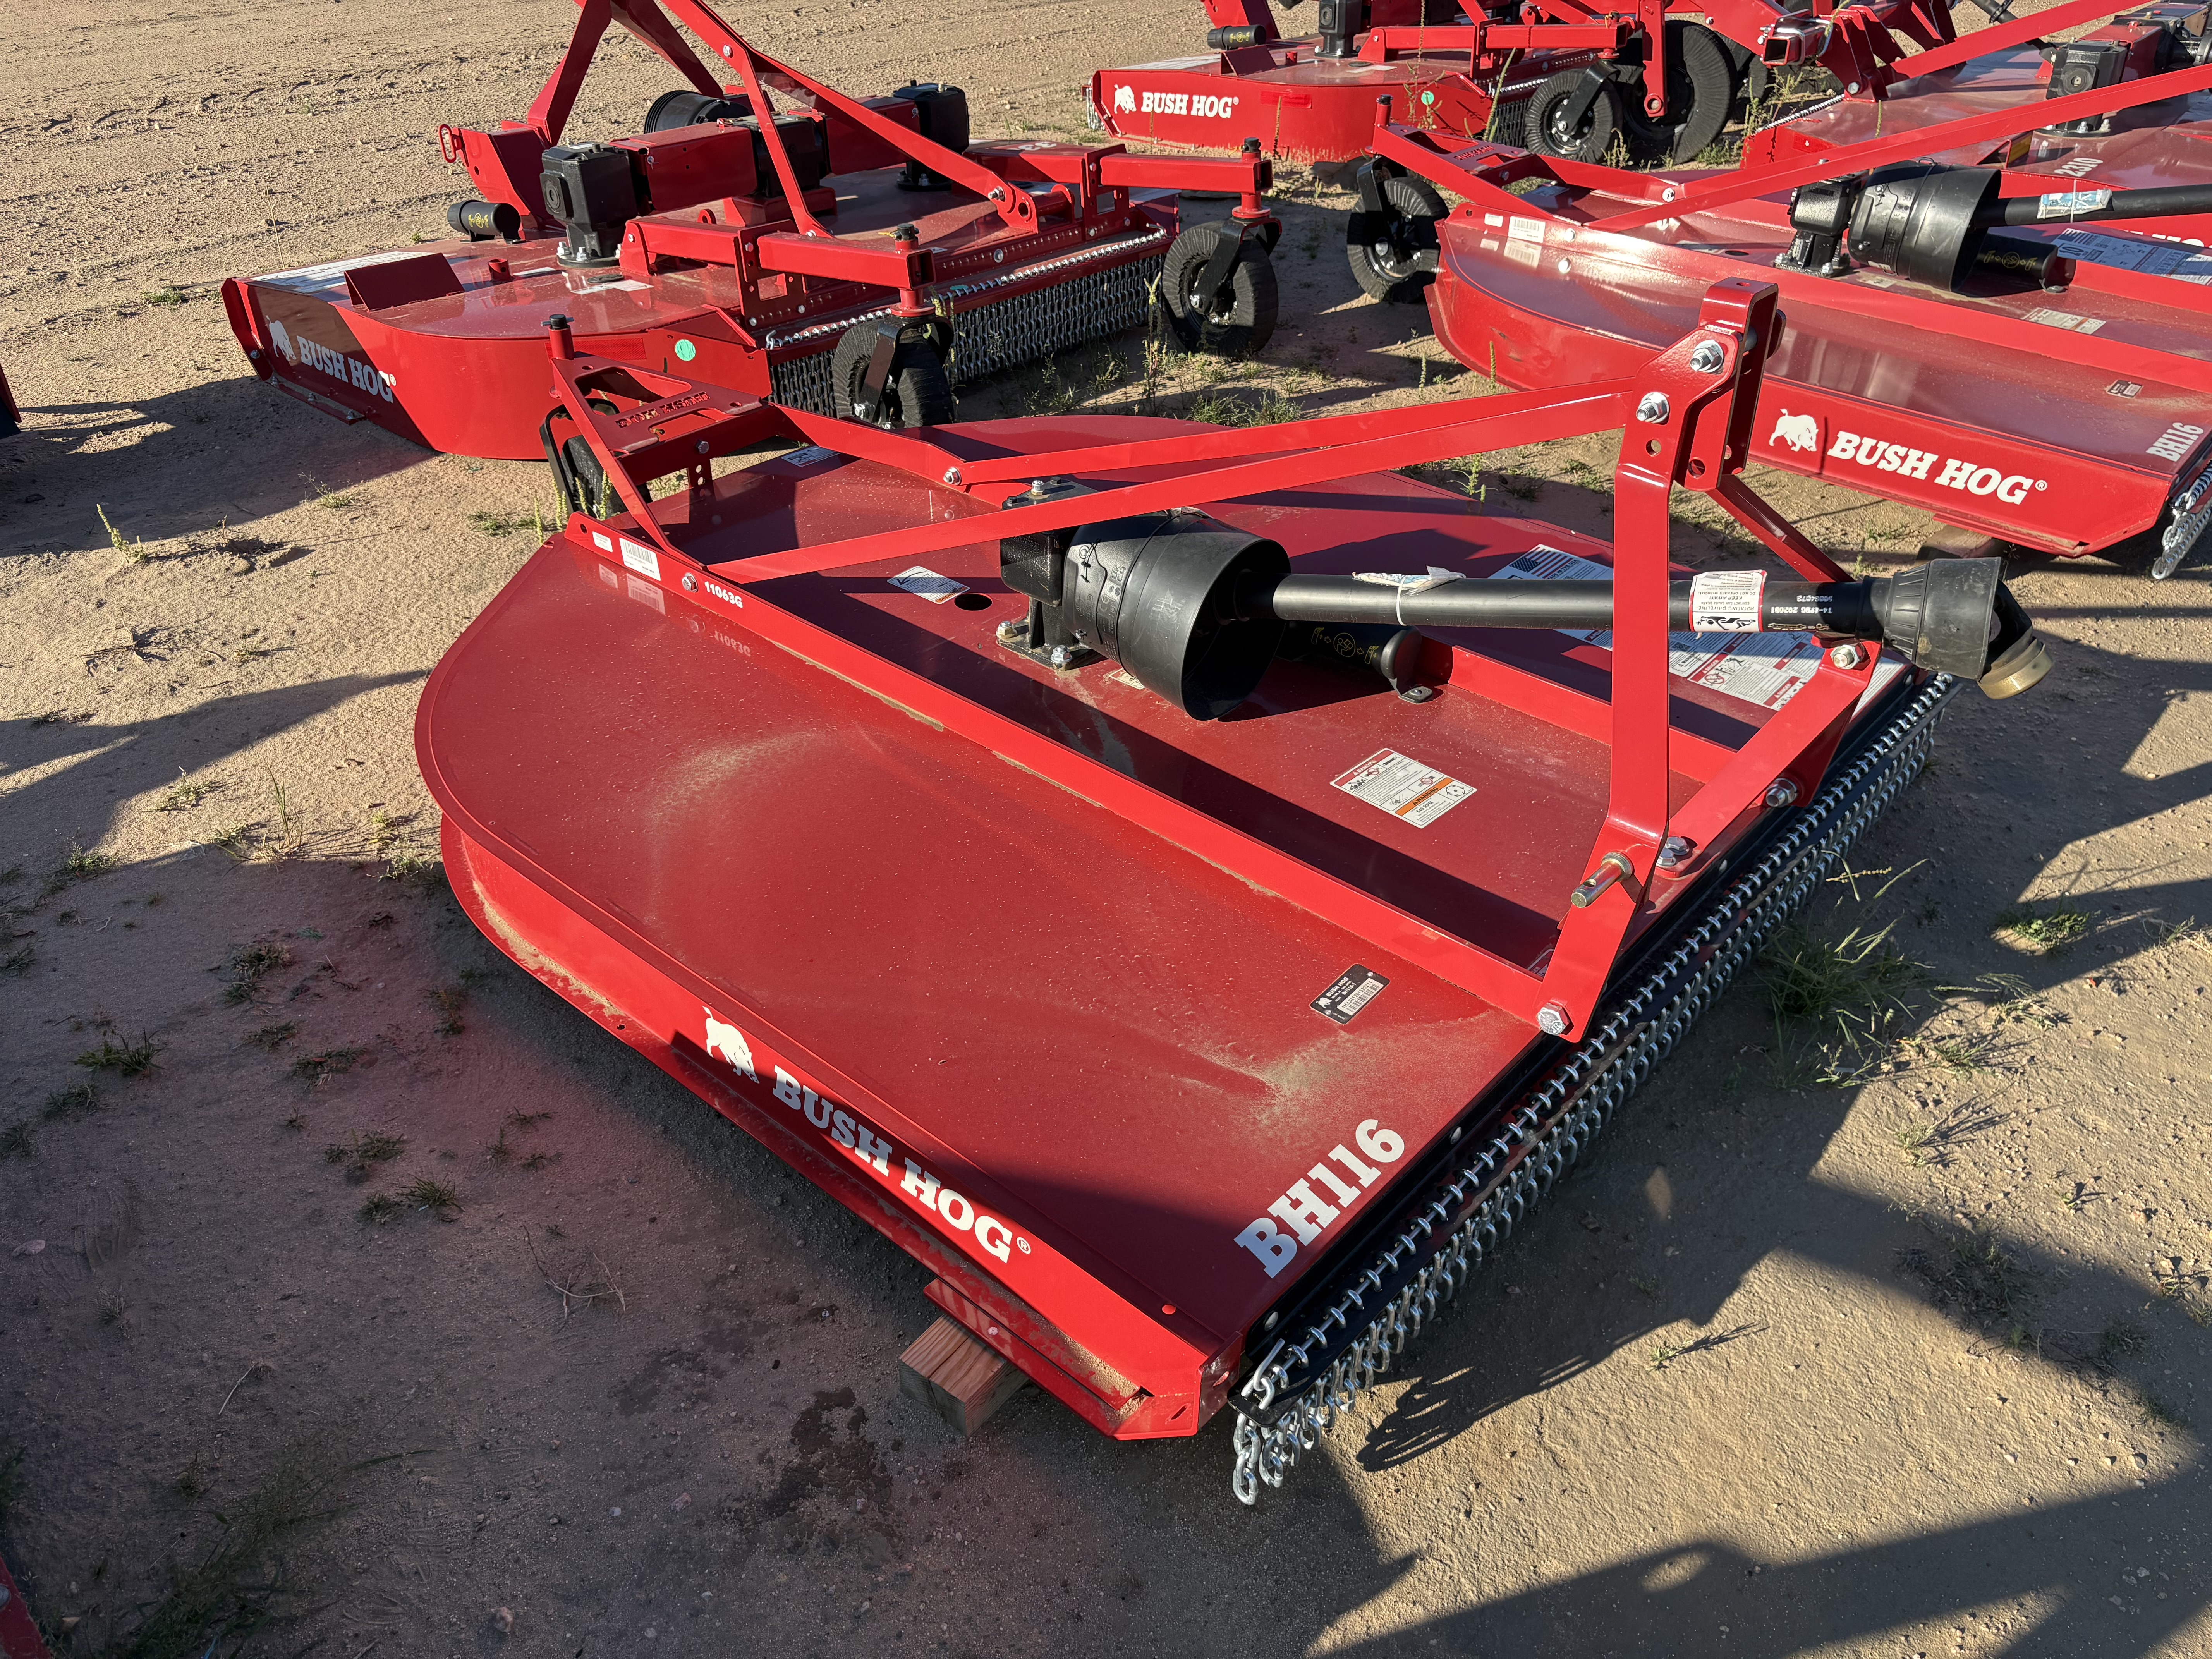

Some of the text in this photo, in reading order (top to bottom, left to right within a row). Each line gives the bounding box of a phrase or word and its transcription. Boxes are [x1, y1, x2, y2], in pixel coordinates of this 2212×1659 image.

[1141, 92, 1189, 115] BUSH
[2054, 158, 2103, 177] 2310
[297, 335, 349, 383] BUSH
[1827, 431, 1939, 481] BUSH
[2146, 422, 2204, 462] BH116
[704, 580, 744, 609] 11063G
[1415, 787, 1439, 802] WARNING
[1326, 985, 1340, 997] BUSH
[1337, 977, 1349, 986] HOG
[772, 1064, 894, 1178] BUSH
[1233, 1118, 1405, 1279] BH116
